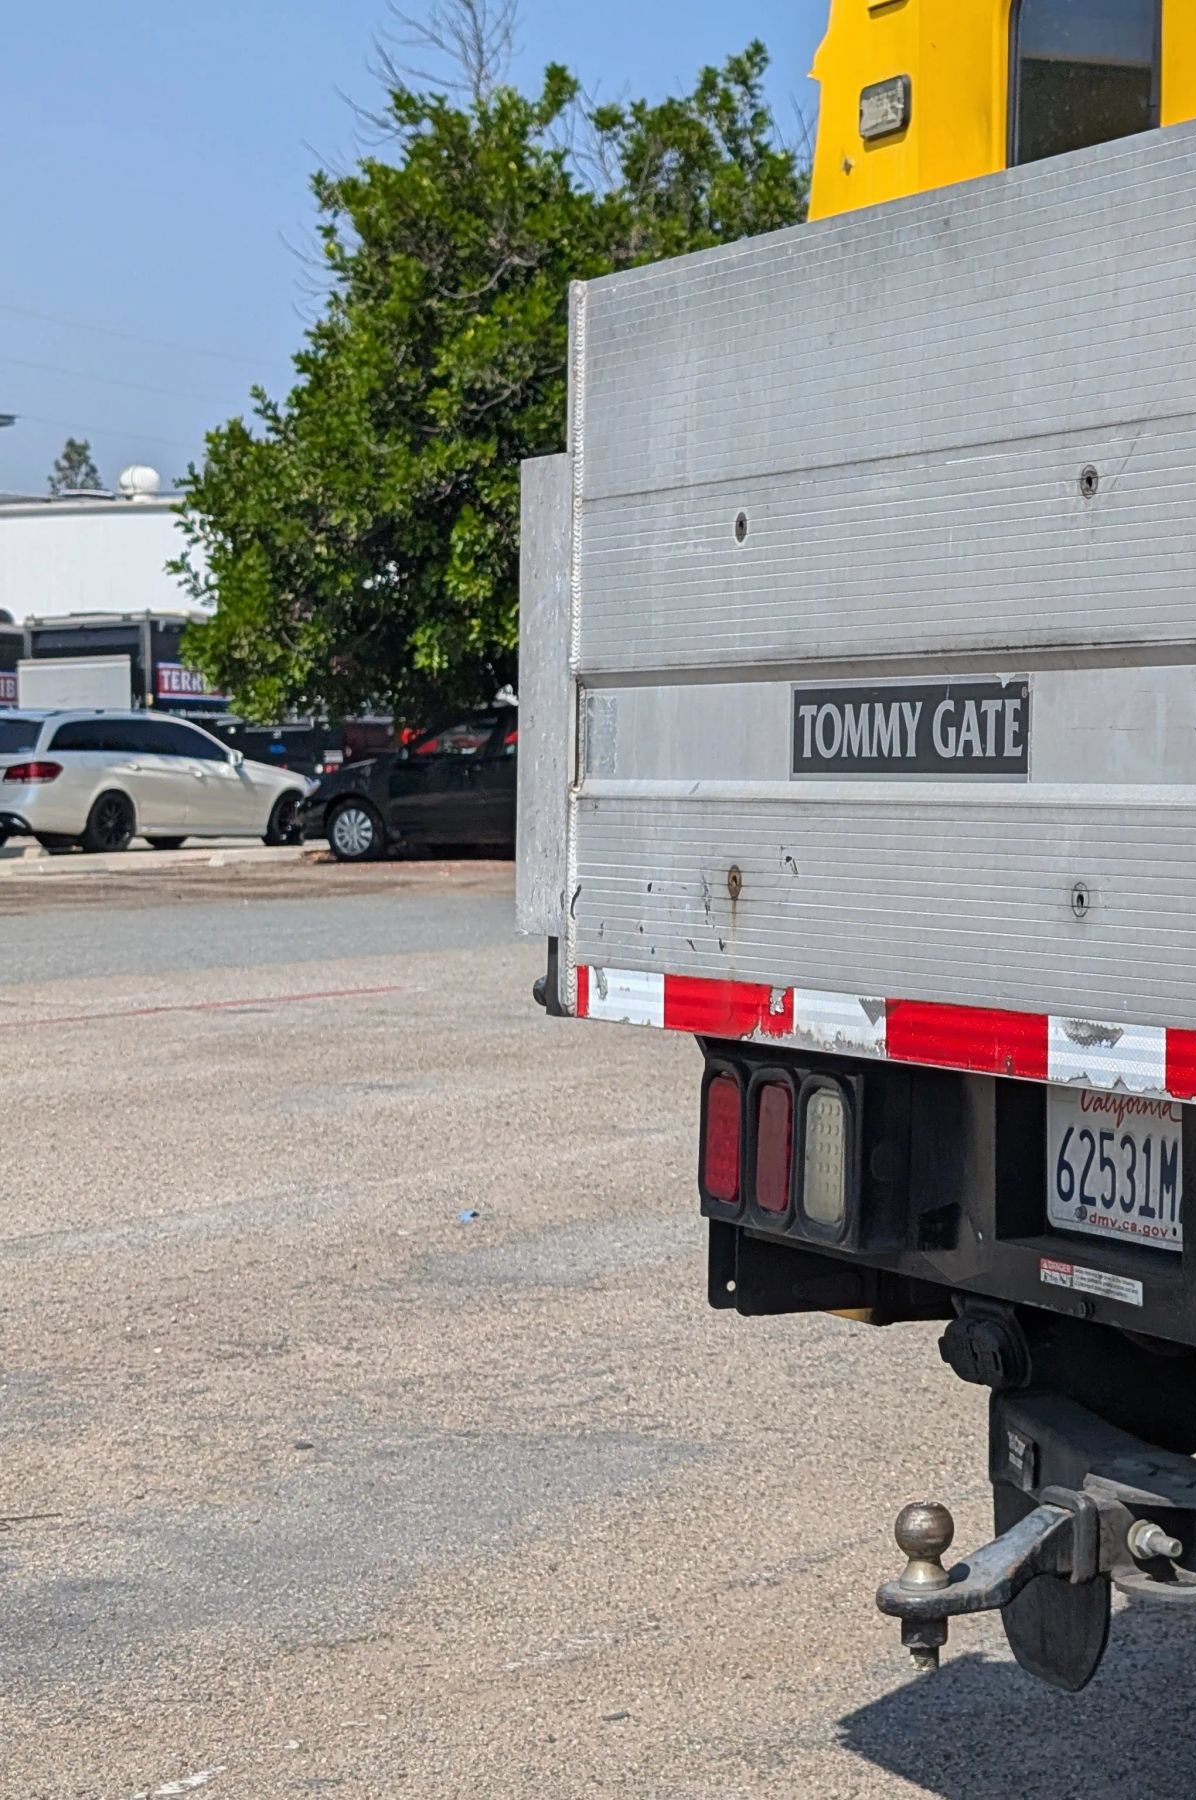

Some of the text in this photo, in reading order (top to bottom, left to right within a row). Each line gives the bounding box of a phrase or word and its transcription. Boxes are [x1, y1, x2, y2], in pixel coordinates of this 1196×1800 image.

[799, 699, 1023, 758] TOMMY GATE
[1080, 1089, 1182, 1128] California
[1057, 1127, 1183, 1223] 62531M
[1089, 1212, 1168, 1237] dmv.ca.gov
